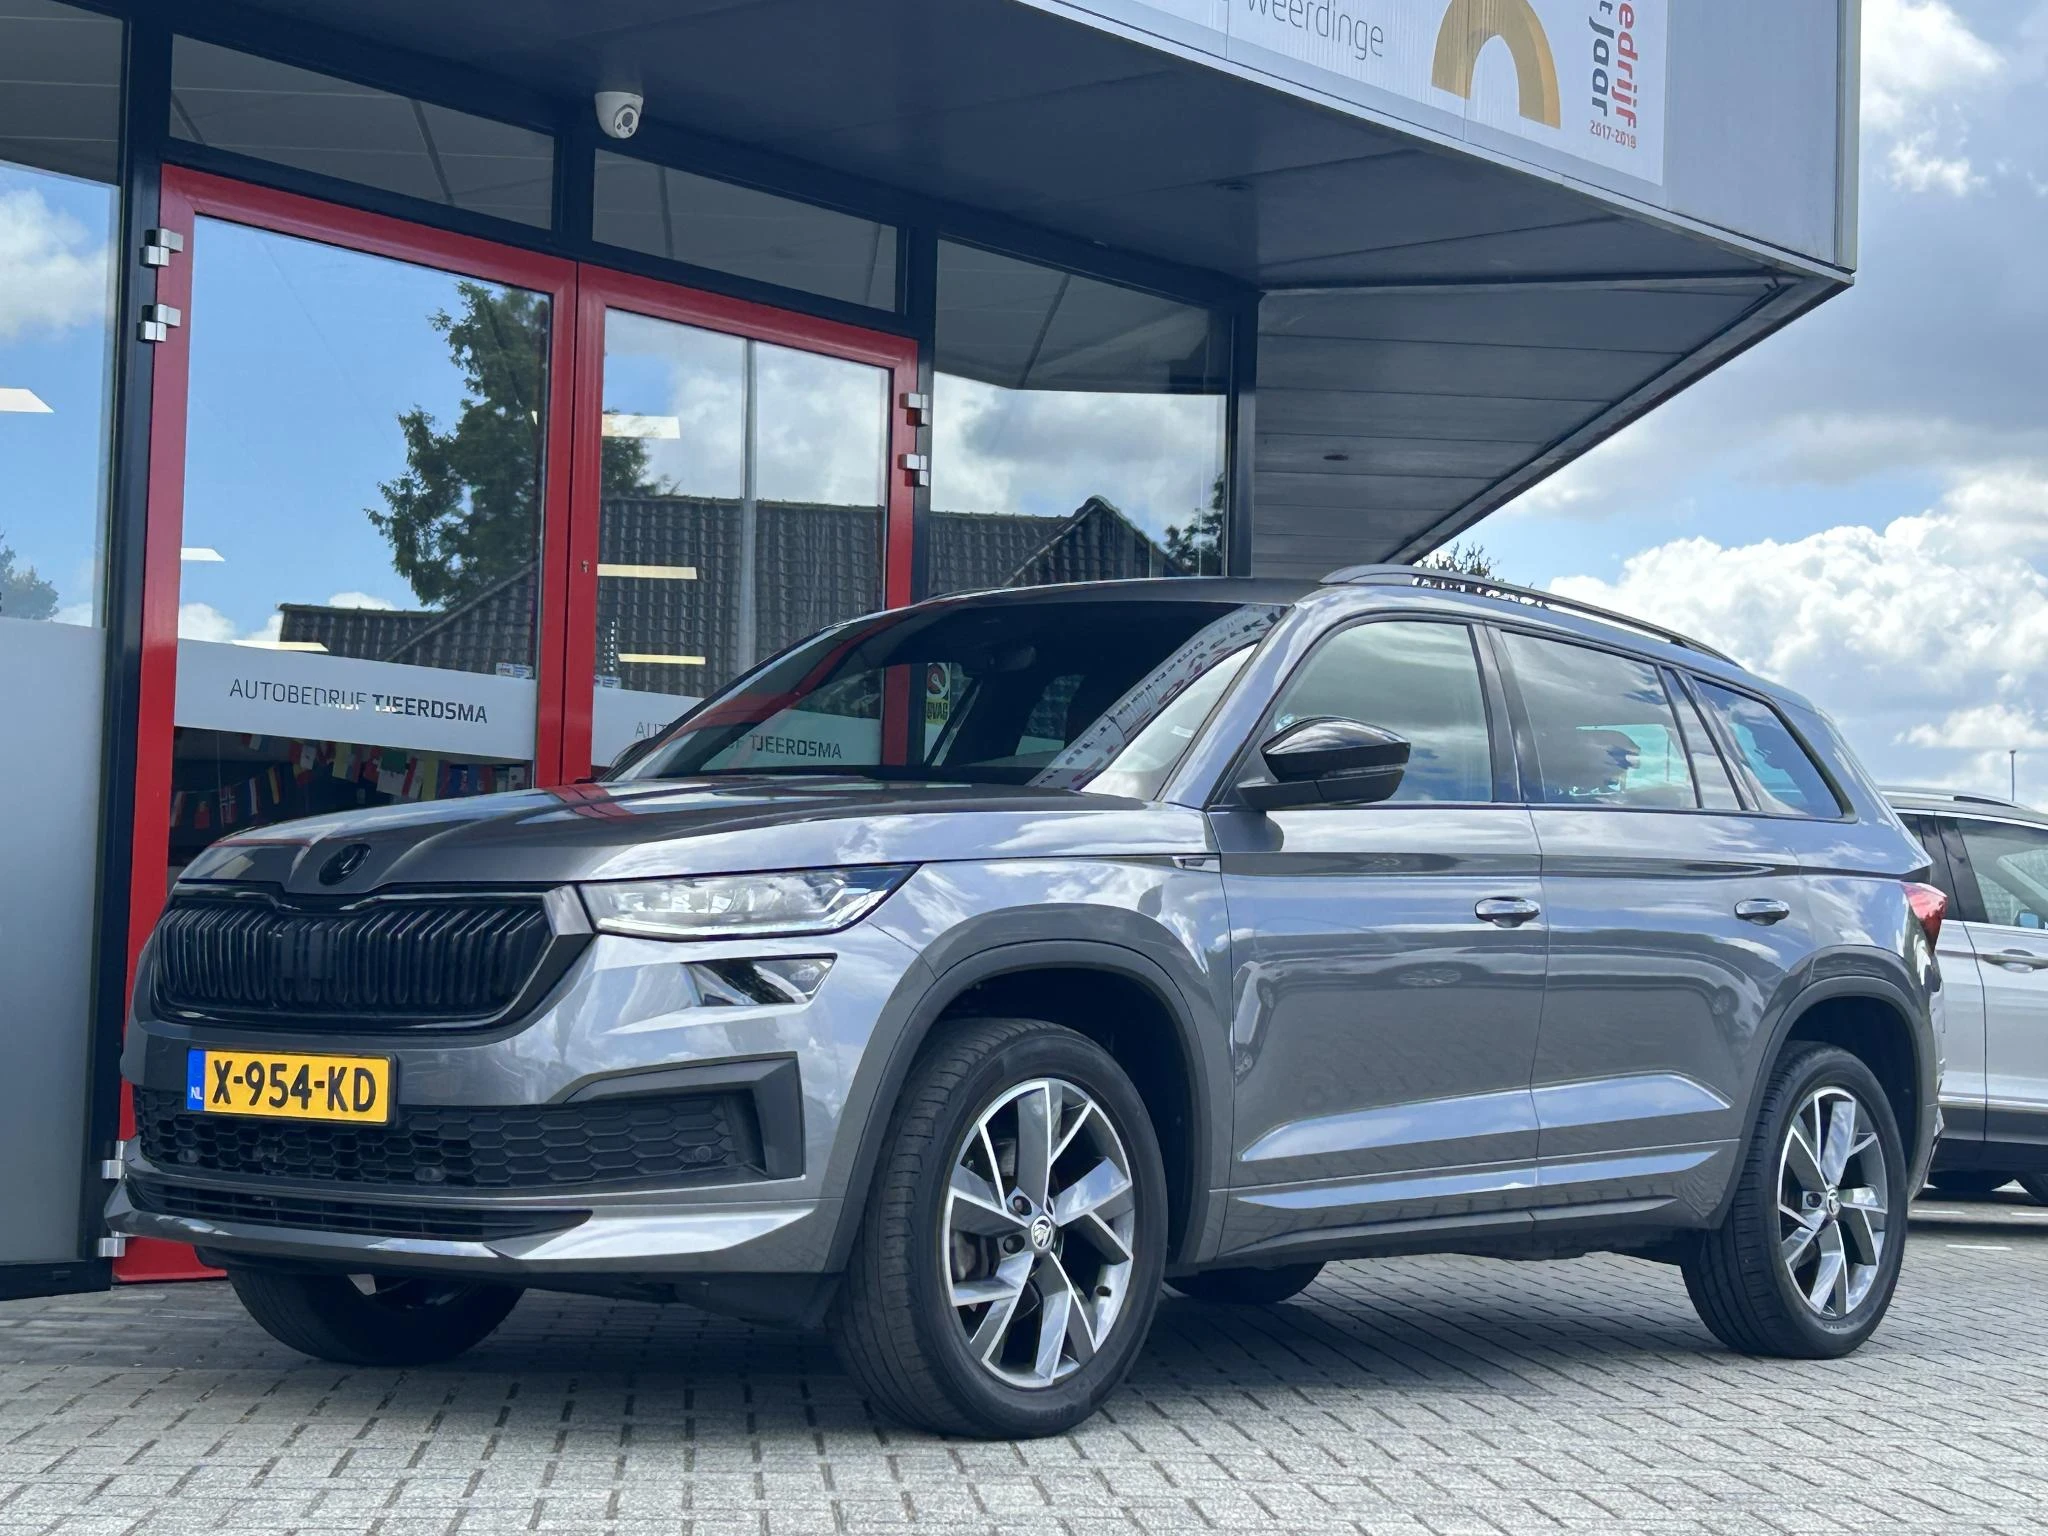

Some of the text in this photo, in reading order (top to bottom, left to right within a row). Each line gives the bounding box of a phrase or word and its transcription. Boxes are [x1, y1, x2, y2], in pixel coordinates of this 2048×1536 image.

[1612, 0, 1638, 128] edrijf
[1590, 120, 1637, 149] 2017-2018
[229, 679, 488, 724] AUTOBEDRIJF TJEERDSMA
[750, 734, 842, 759] TJEERDSMA
[190, 1086, 203, 1100] NL
[212, 1059, 377, 1113] X-954-KD
